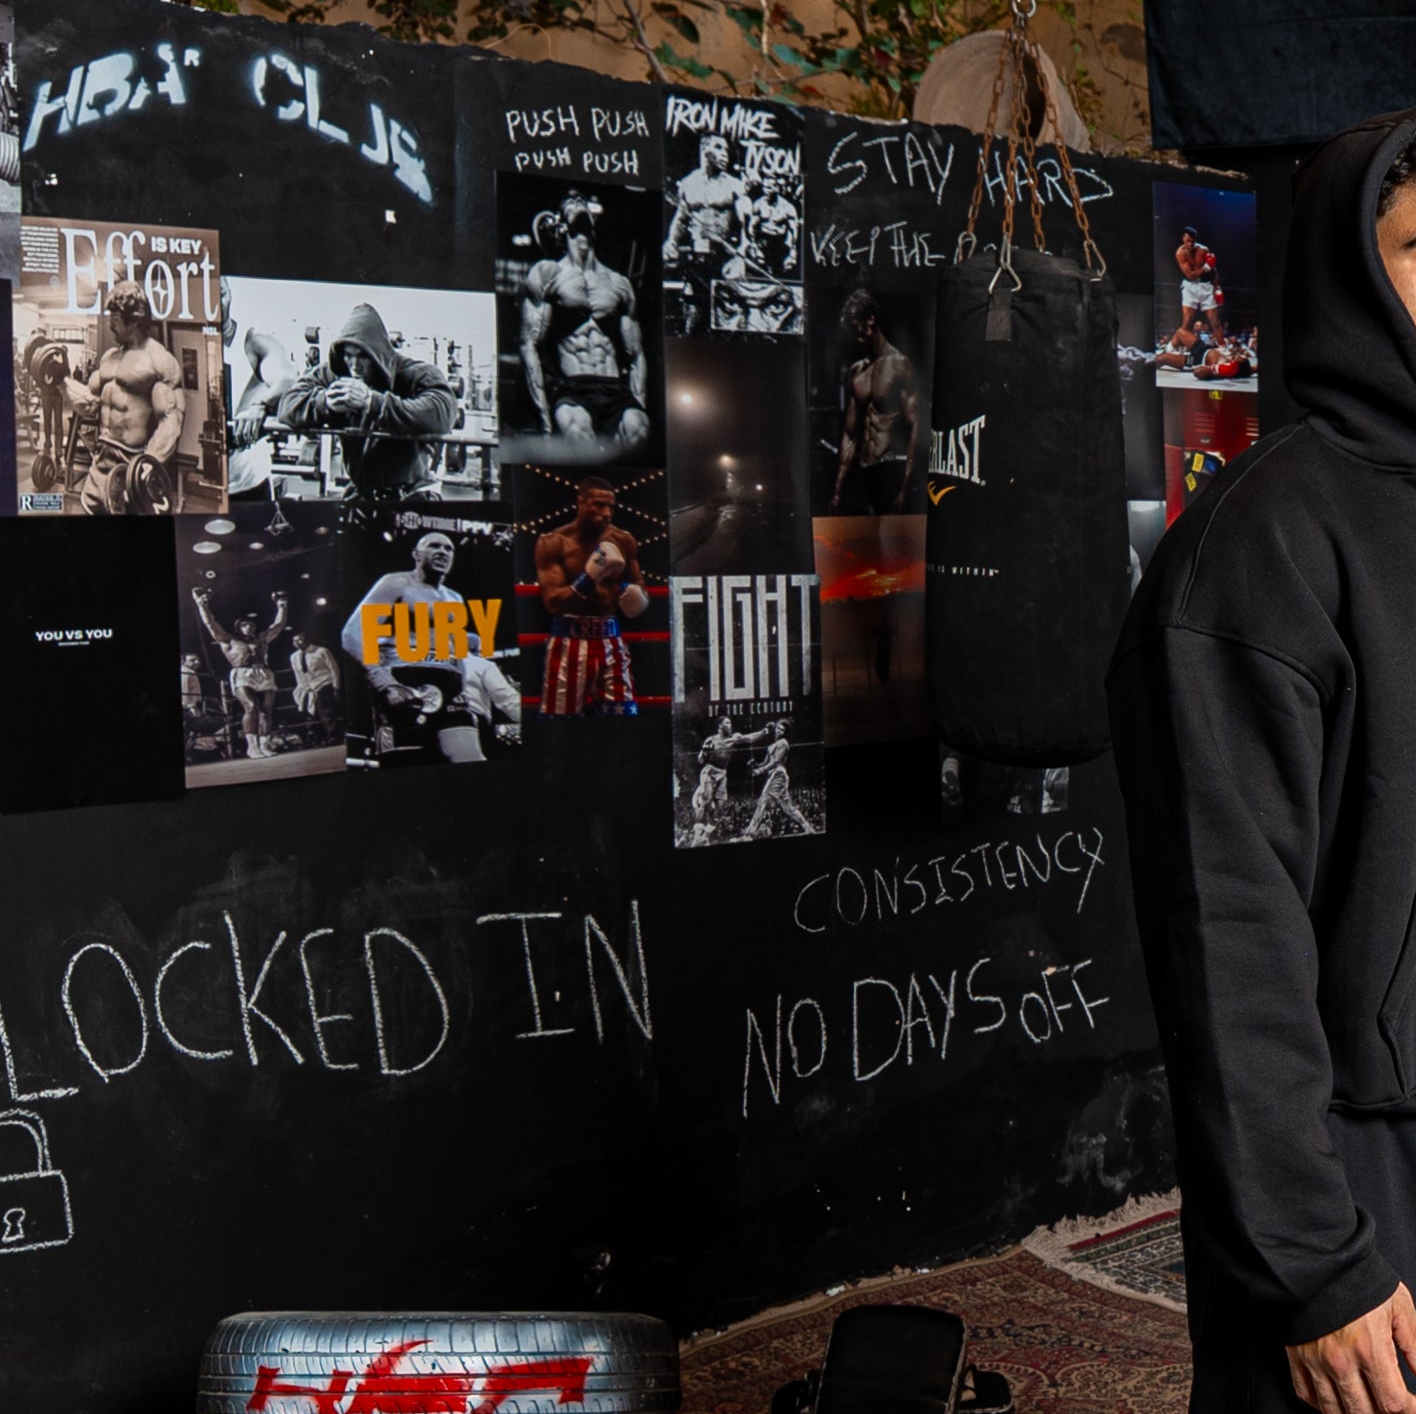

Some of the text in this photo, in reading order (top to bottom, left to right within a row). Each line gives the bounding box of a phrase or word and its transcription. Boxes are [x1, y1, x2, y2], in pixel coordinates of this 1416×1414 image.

[506, 105, 650, 143] PUSH PUSH
[665, 95, 781, 140] IRON MIKE
[514, 146, 640, 177] PUSH PUSH
[740, 138, 801, 181] TYSON
[827, 132, 1114, 208] STAY HARD
[151, 236, 202, 255] IS KEY
[884, 221, 946, 267] THE
[60, 227, 219, 322] Effort
[928, 415, 986, 485] RLAST
[21, 495, 33, 510] R
[35, 628, 113, 642] YOU VS YOU
[361, 598, 502, 666] FURY
[671, 574, 820, 703] FIGHT
[794, 827, 1104, 933] CONSISTENCY
[0, 899, 653, 1102] LOCKED IN
[743, 958, 1109, 1119] NO DAYS OFF
